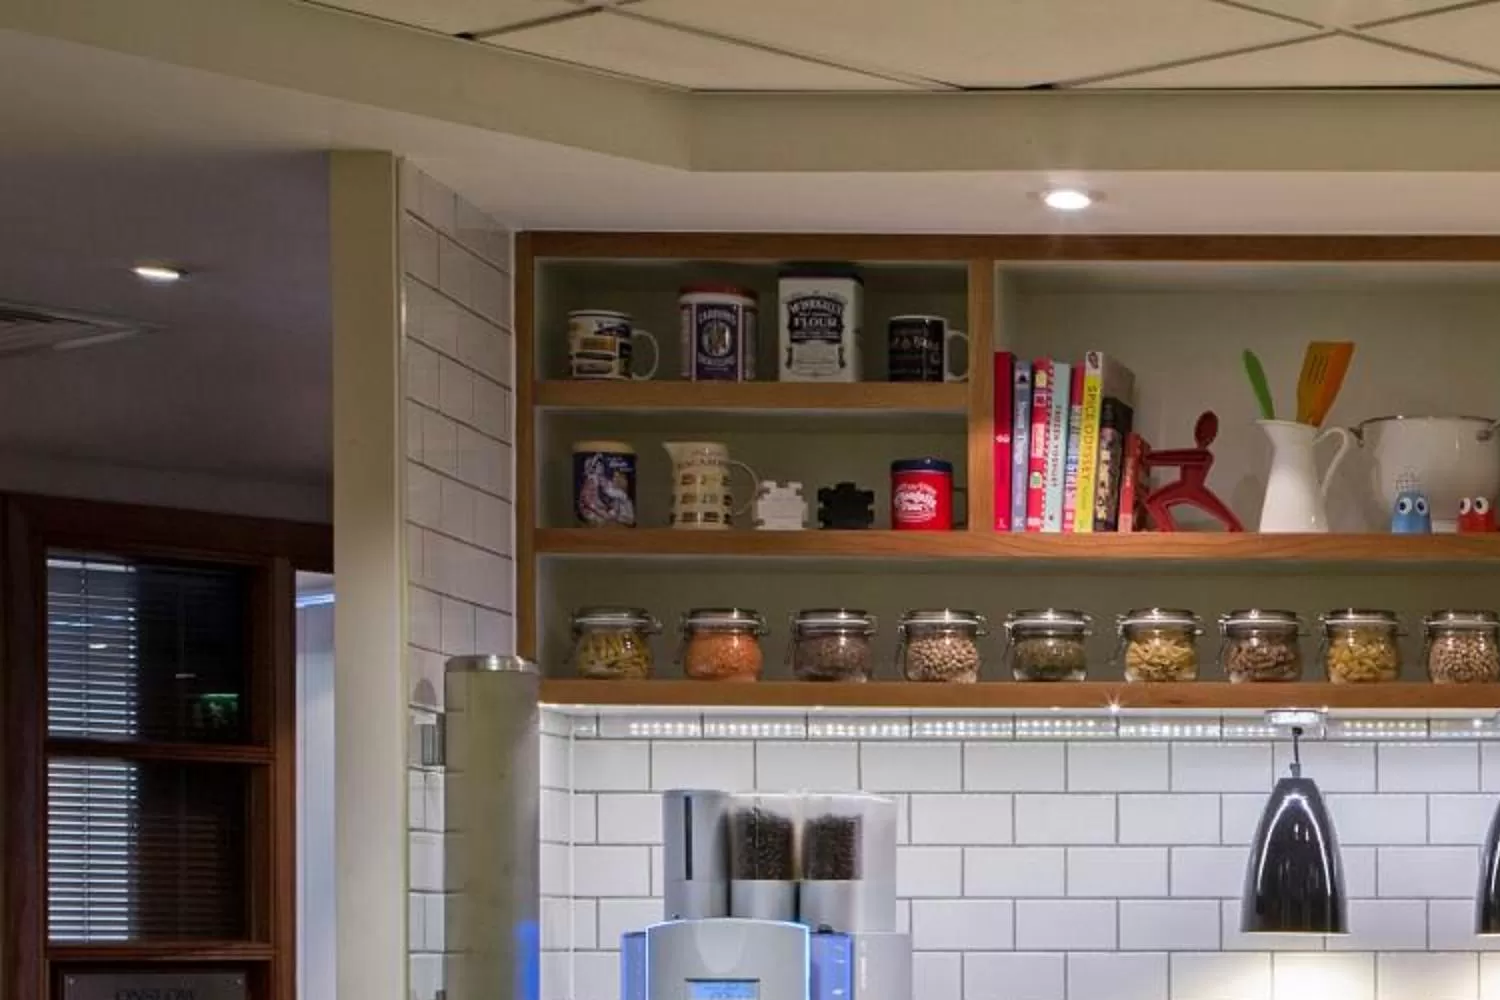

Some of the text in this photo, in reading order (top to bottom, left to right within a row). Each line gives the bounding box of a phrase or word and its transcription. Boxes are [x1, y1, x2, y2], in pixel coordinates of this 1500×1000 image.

[1053, 404, 1062, 442] FROZEN
[1081, 384, 1098, 482] SPICE ODYSSEY
